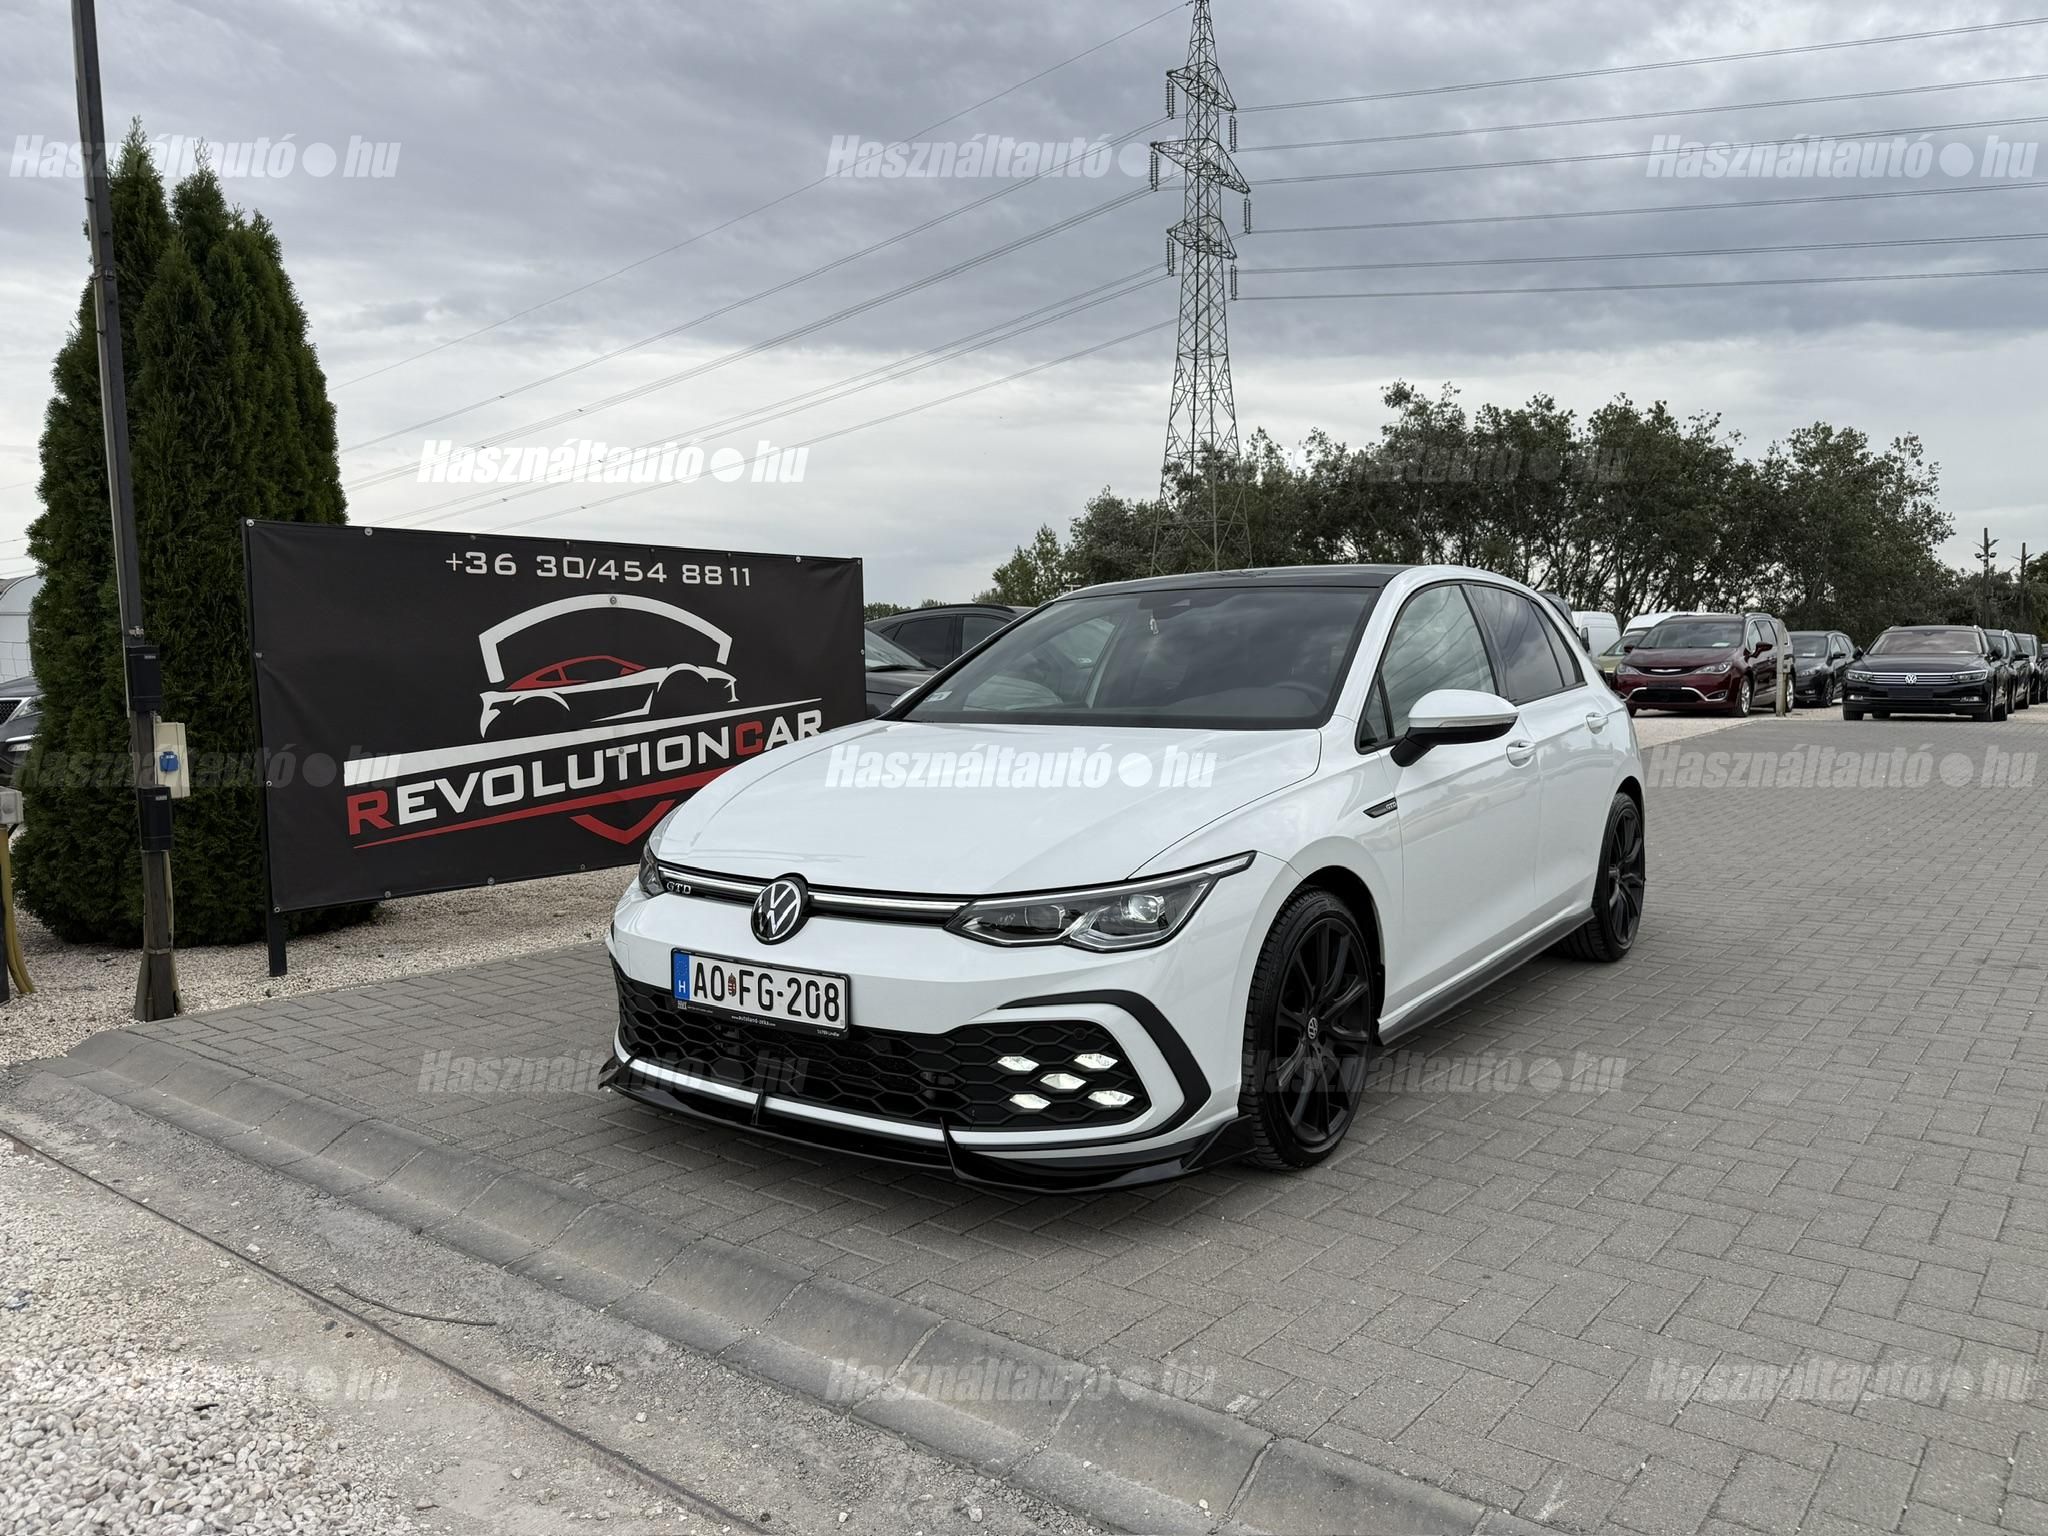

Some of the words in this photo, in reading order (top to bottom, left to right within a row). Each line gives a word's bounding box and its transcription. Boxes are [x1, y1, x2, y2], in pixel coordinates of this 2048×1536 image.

[446, 552, 517, 576] +36
[536, 555, 668, 583] 30/454
[682, 564, 750, 587] 8811
[666, 881, 692, 895] GTD
[678, 979, 686, 994] H
